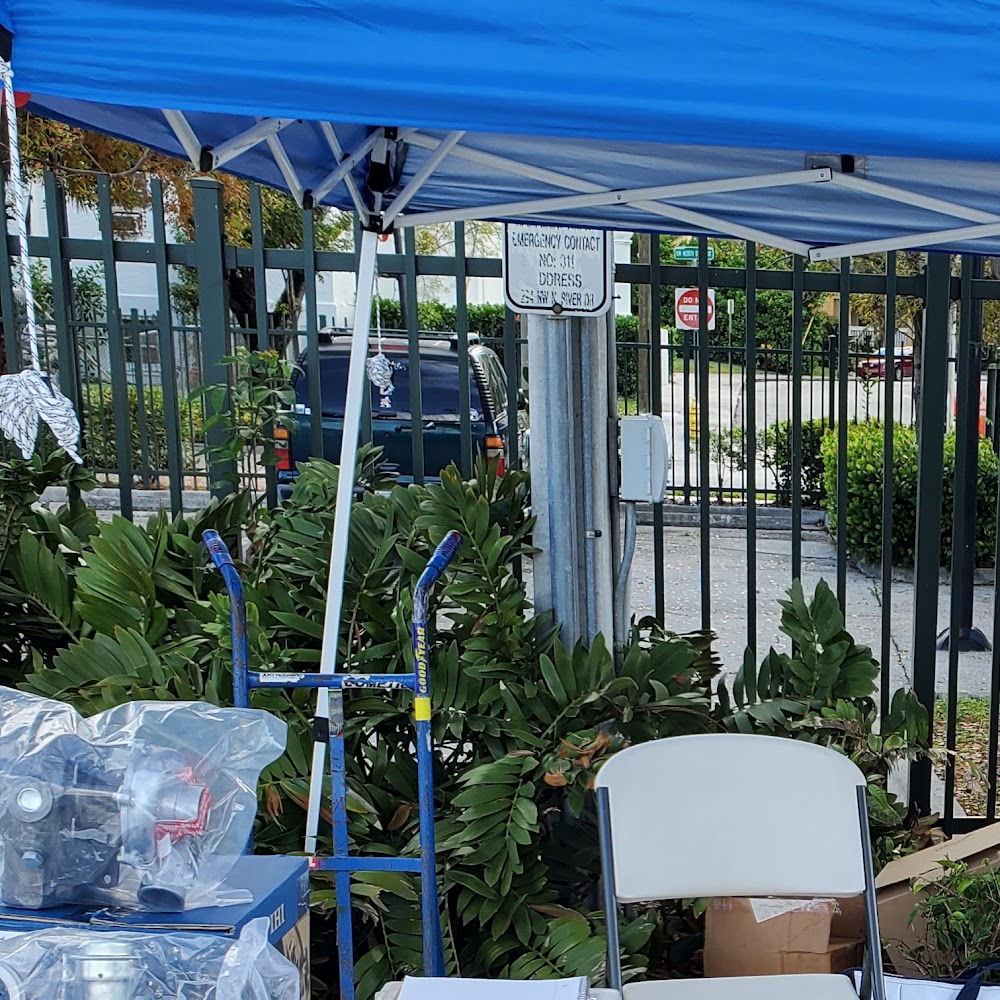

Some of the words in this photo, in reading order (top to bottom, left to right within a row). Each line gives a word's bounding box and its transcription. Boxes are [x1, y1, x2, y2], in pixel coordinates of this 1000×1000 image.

[512, 231, 562, 250] EMERGENCY
[564, 235, 601, 251] CONTACT
[269, 902, 286, 935] IHI
